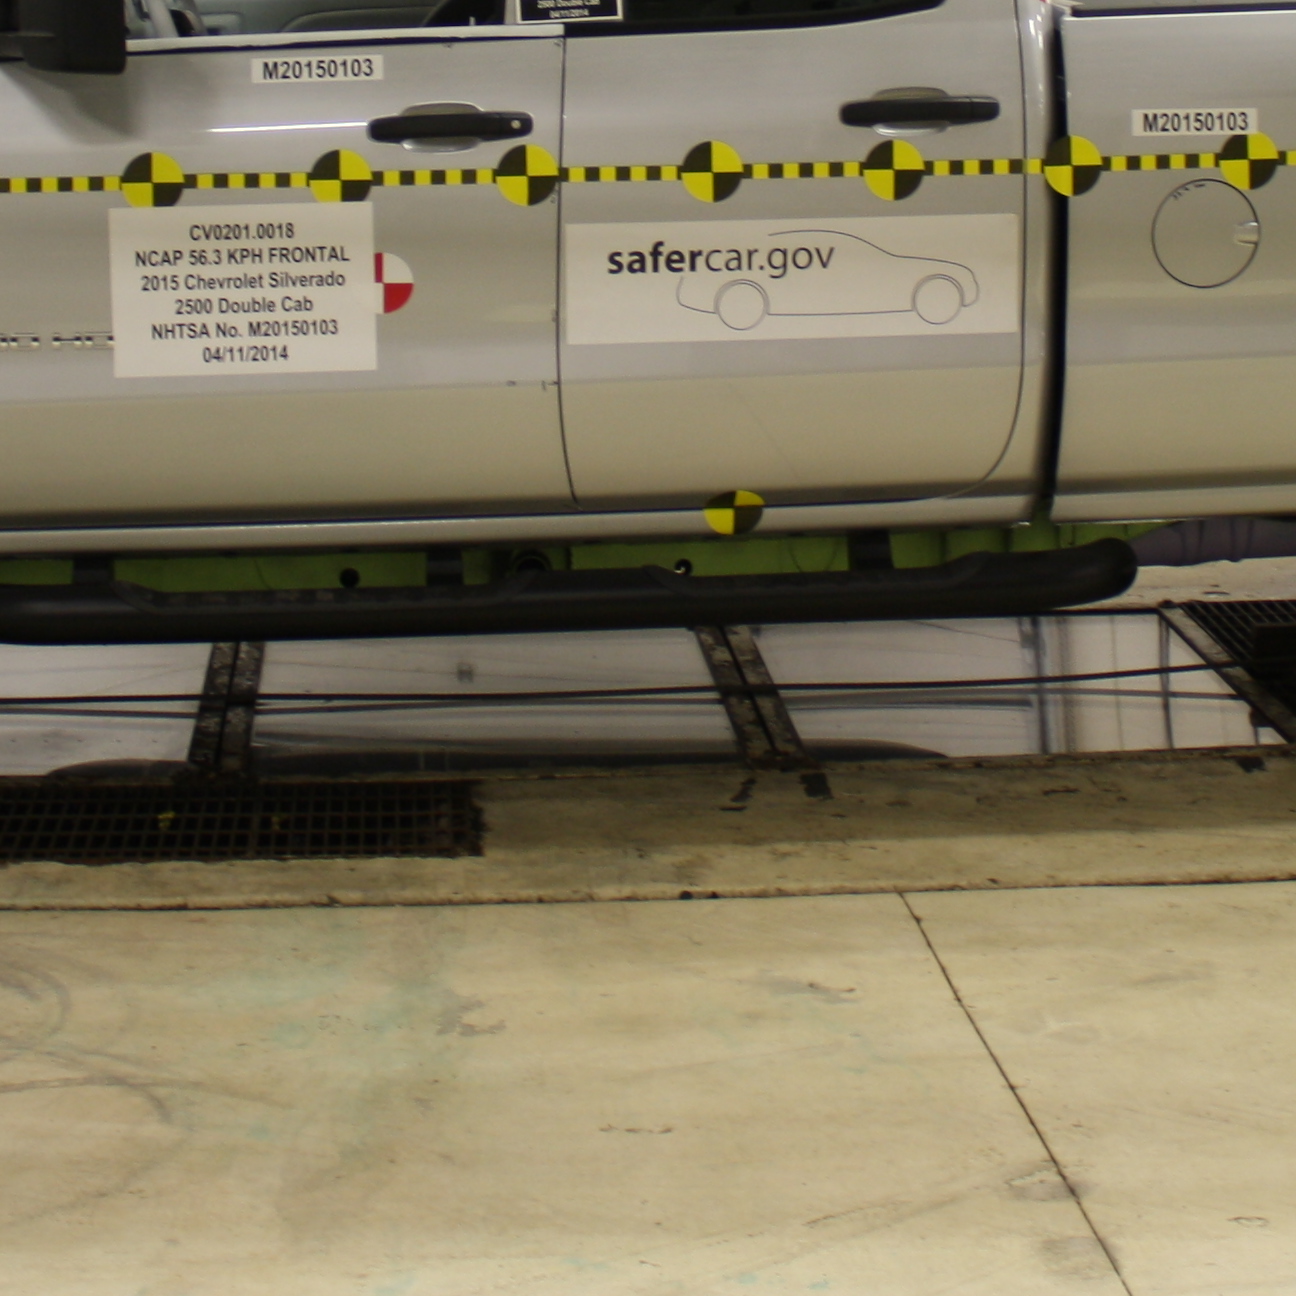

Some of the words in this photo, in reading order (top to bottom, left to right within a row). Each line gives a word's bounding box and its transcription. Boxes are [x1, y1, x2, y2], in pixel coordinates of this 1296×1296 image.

[262, 58, 374, 80] M20150103
[1142, 111, 1249, 132] M20150103
[189, 223, 295, 241] CV0201.0018
[134, 250, 183, 268] NCAP
[188, 249, 222, 266] 56.3
[227, 248, 263, 265] KPH
[268, 245, 351, 264] FRONTAL
[607, 241, 835, 279] safercar.gov
[140, 274, 180, 291] 2015
[184, 271, 264, 290] Chevrolet
[268, 270, 346, 288] Silverado
[174, 298, 213, 315] 2500
[218, 296, 277, 314] Double
[281, 295, 314, 312] Cab
[151, 322, 211, 340] NHTSA
[215, 322, 244, 338] No.
[248, 319, 339, 337] M20150103
[202, 345, 289, 363] 04/11/2014
